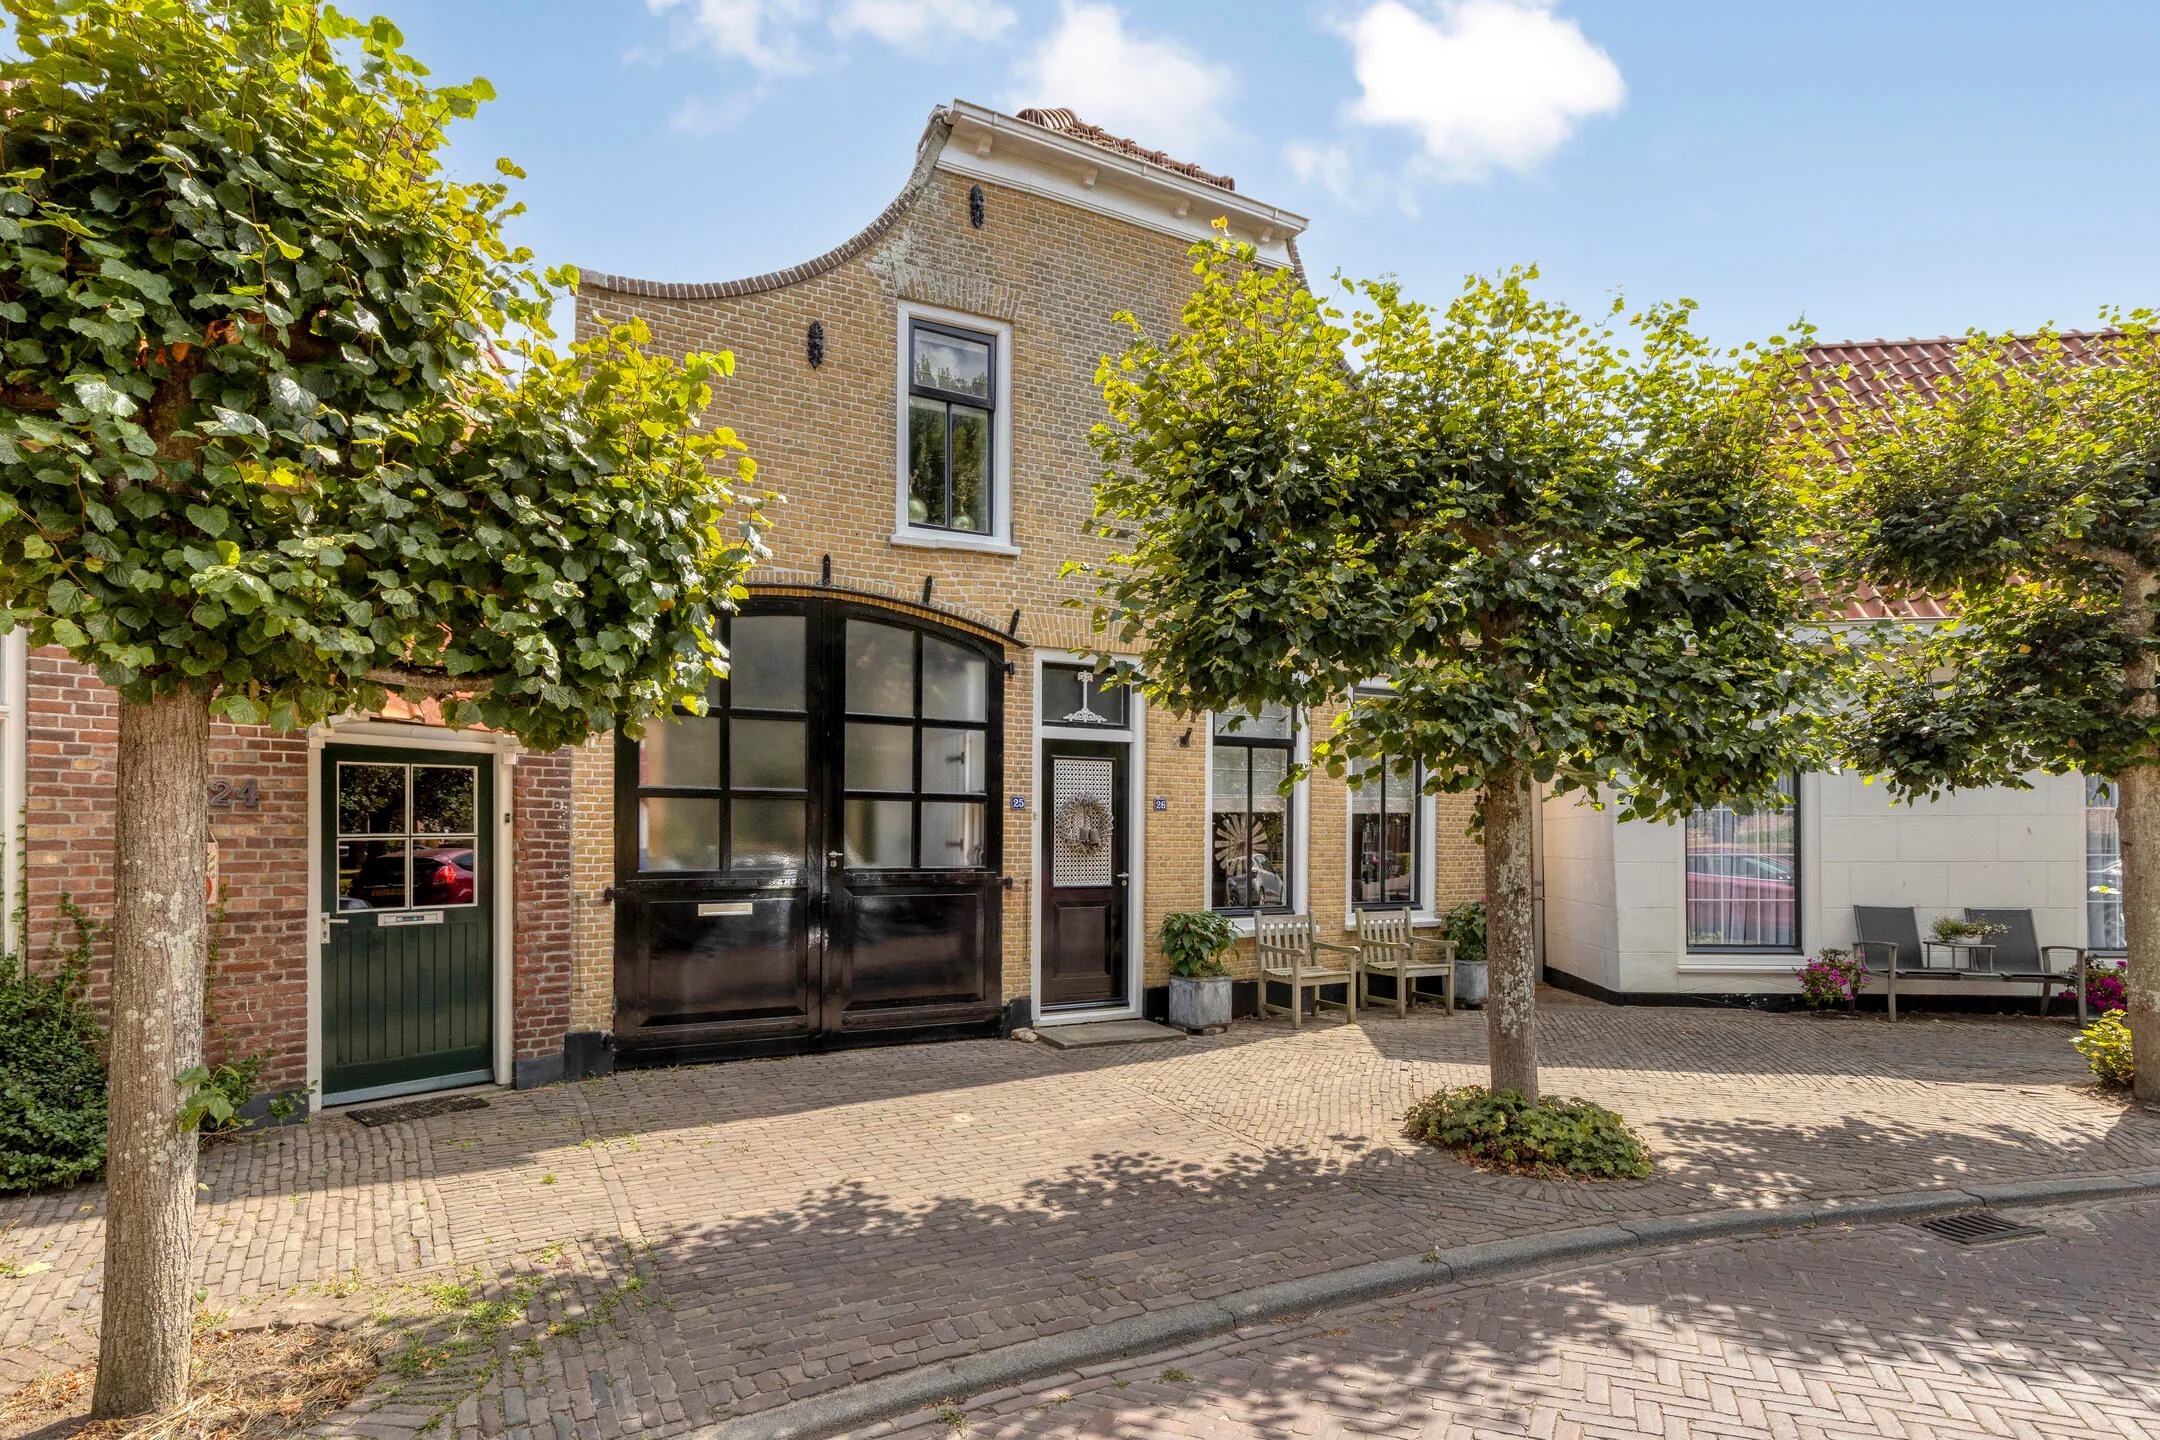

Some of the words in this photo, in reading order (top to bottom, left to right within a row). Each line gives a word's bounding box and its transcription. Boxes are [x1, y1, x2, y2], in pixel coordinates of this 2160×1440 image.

[209, 779, 259, 808] 24
[1012, 798, 1025, 808] 25
[1155, 800, 1167, 810] 26
